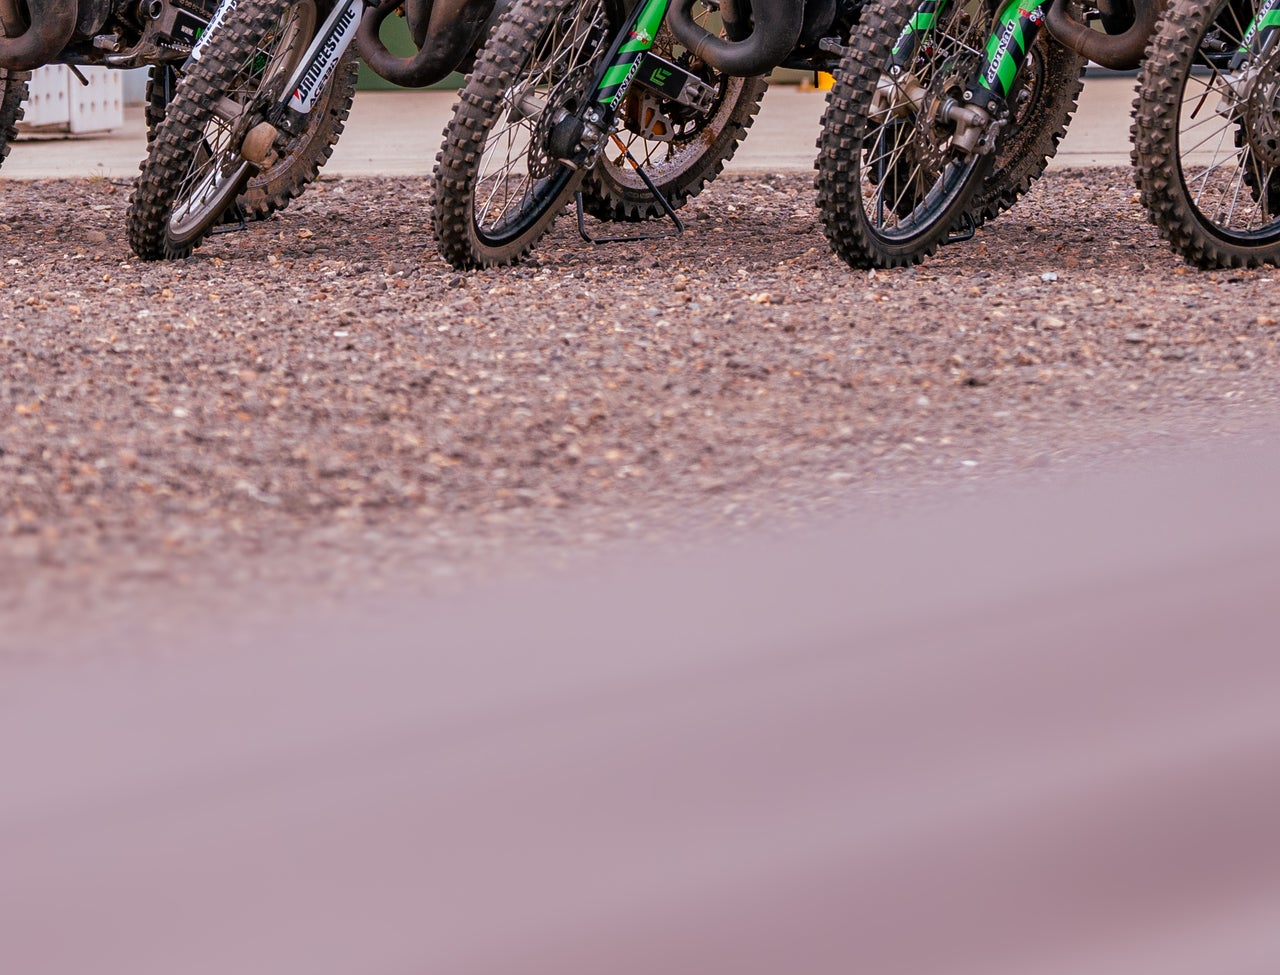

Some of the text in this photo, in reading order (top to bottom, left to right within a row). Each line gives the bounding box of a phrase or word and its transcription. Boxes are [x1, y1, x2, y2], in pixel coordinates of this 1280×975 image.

[296, 8, 356, 104] BRIDGESTONE
[609, 52, 642, 112] DUNLOP
[987, 19, 1017, 84] DUNLOP
